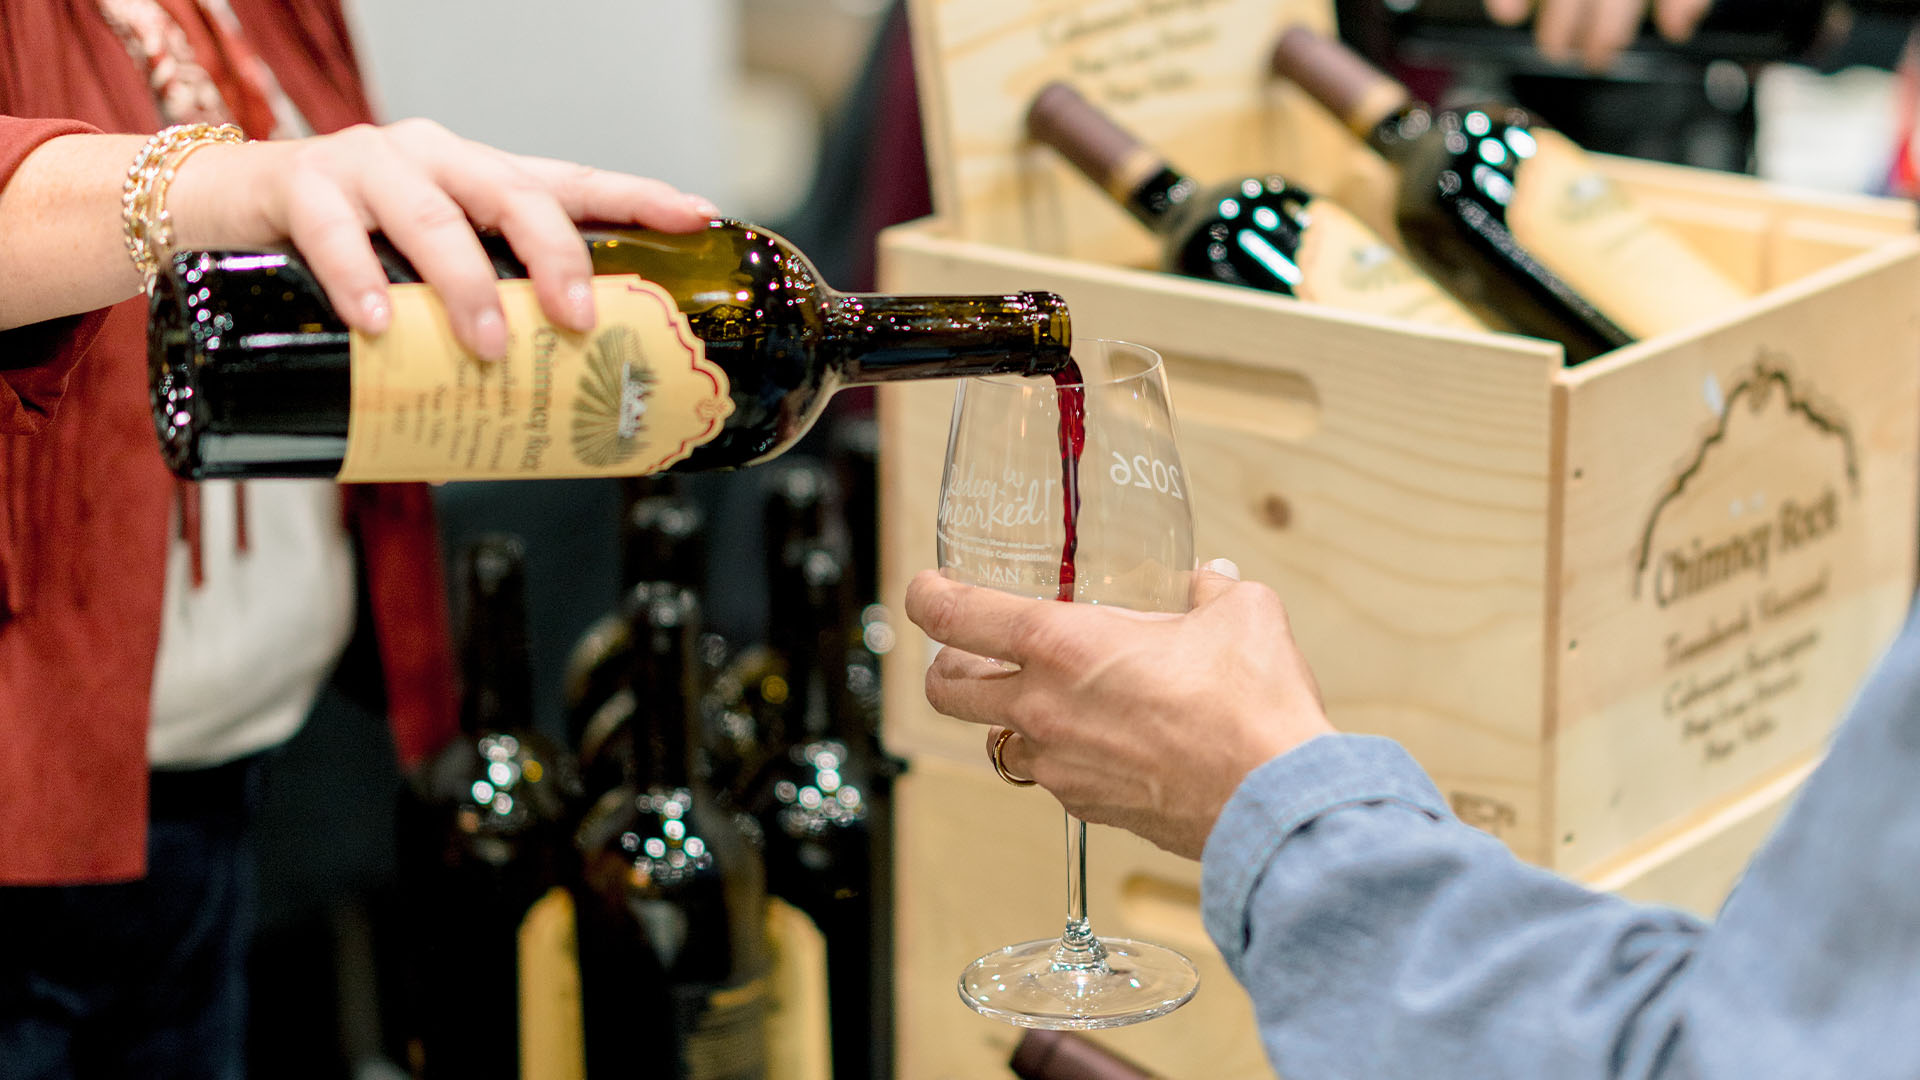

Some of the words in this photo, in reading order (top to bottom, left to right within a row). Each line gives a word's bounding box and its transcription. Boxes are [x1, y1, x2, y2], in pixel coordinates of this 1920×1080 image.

[524, 326, 558, 432] Chimney
[995, 549, 1052, 562] Competition
[1656, 525, 1771, 608] Chimney
